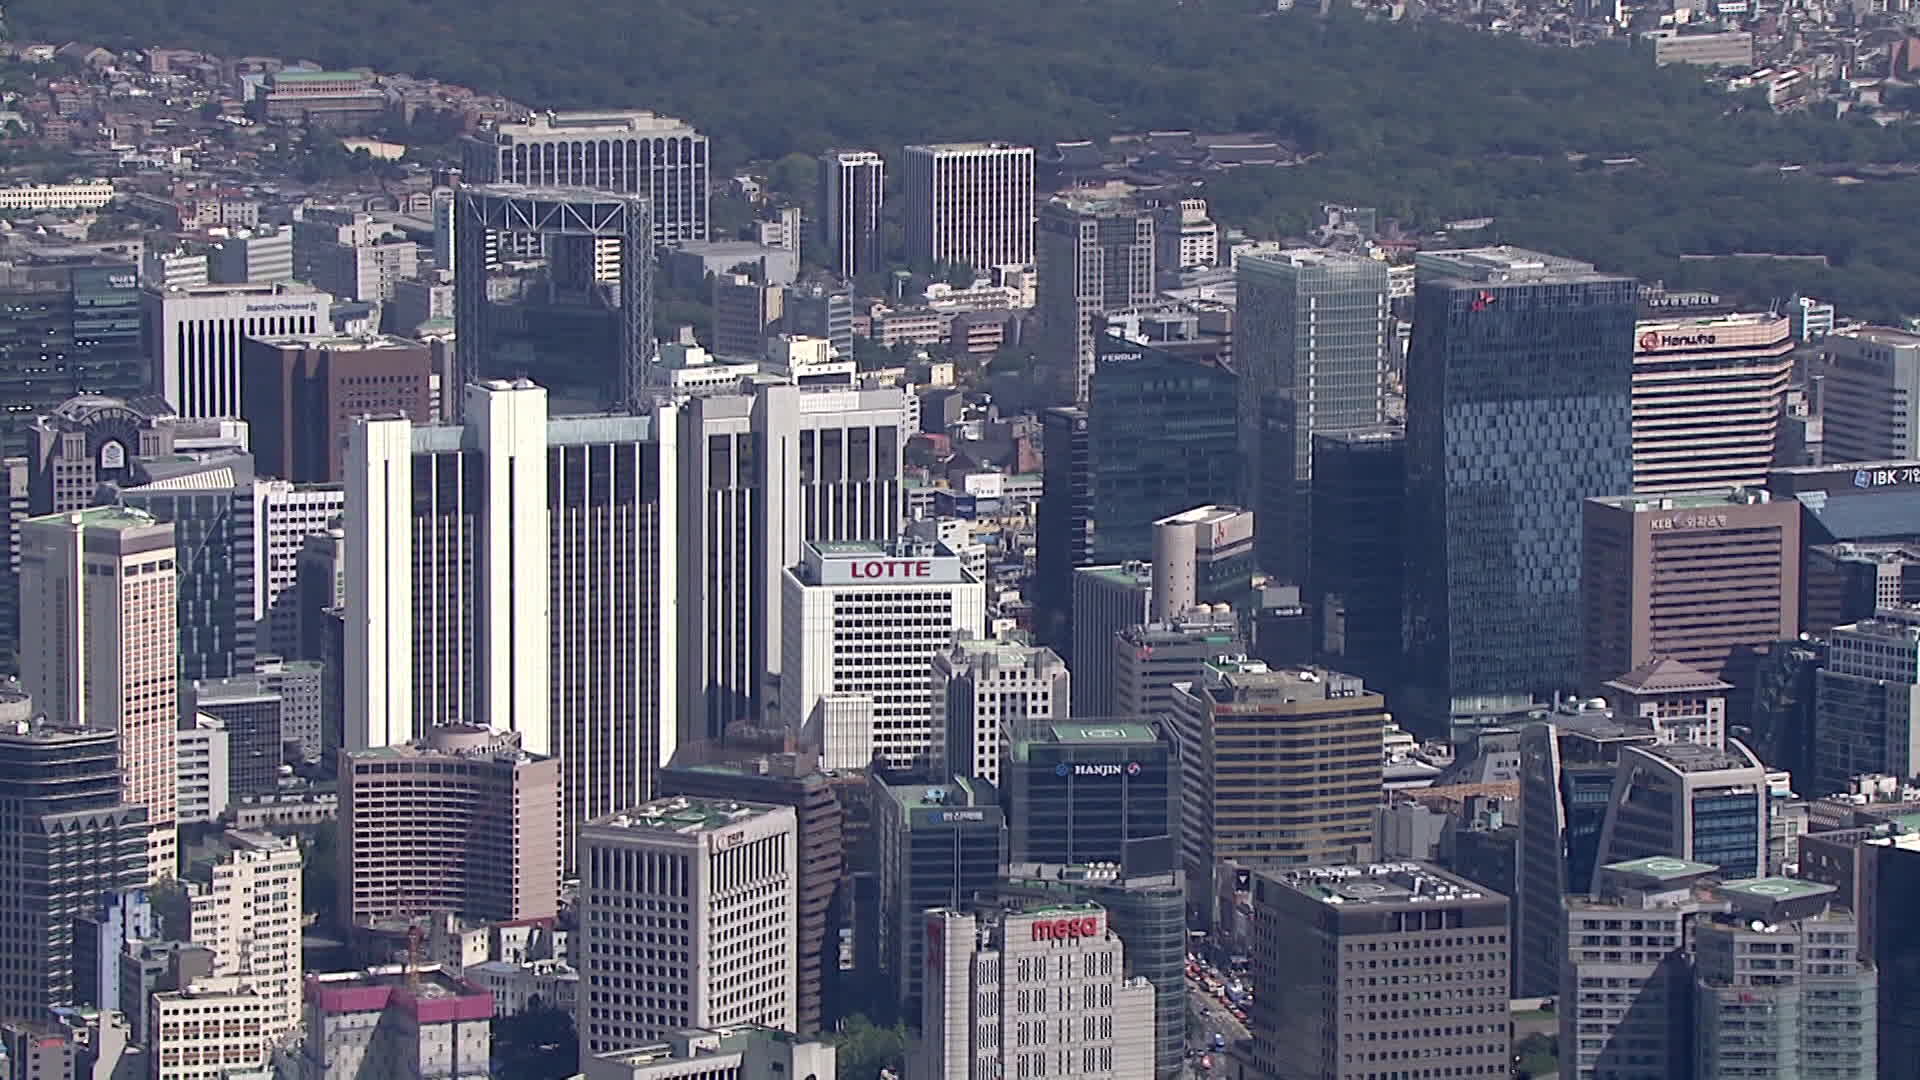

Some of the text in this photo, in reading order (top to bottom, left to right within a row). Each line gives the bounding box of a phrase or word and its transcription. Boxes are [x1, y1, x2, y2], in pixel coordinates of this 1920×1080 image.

[1662, 334, 1716, 346] Hanwha
[1102, 353, 1142, 362] FERRUM
[1873, 470, 1897, 485] IBK
[851, 561, 930, 578] LOTTE
[1075, 764, 1121, 776] HANJIN
[1032, 917, 1097, 941] mesa
